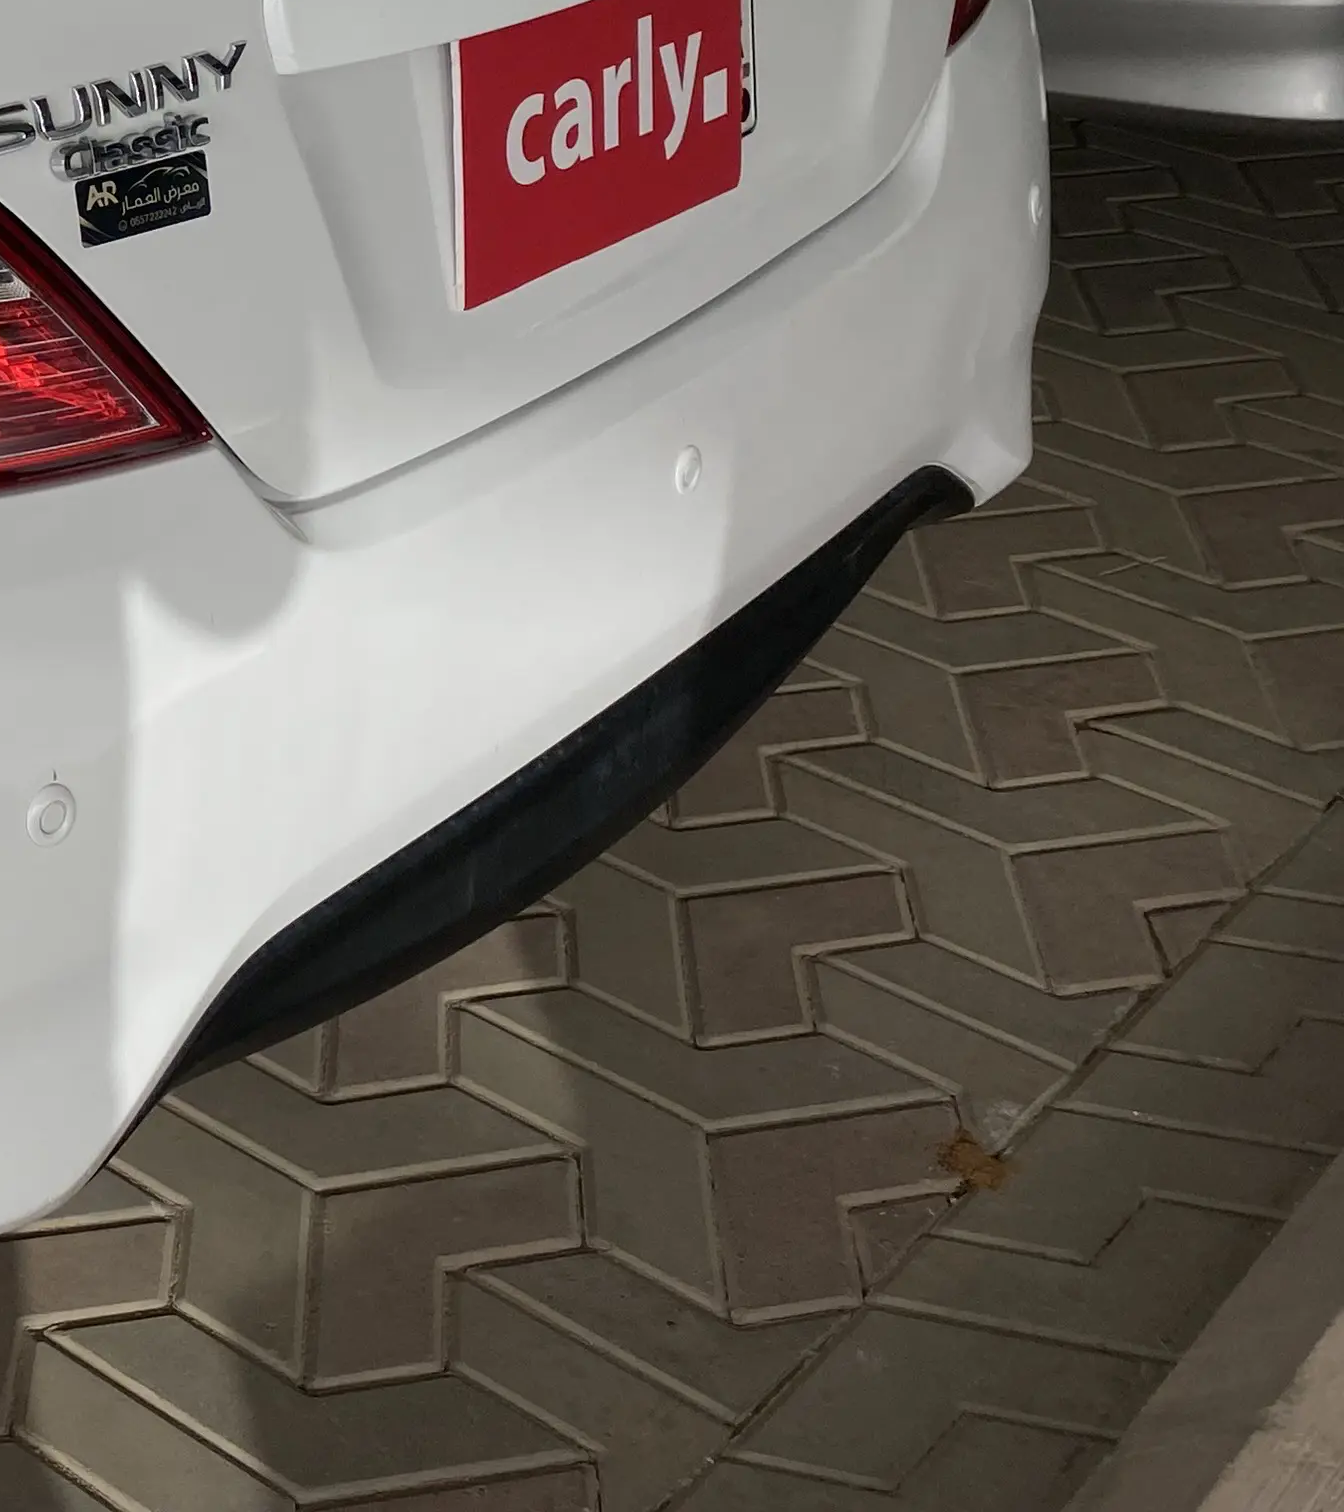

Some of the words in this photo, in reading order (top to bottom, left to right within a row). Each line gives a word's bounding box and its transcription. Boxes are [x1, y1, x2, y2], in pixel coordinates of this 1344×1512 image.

[506, 14, 728, 186] carly.
[121, 186, 162, 216] العمار
[163, 182, 200, 204] معرض
